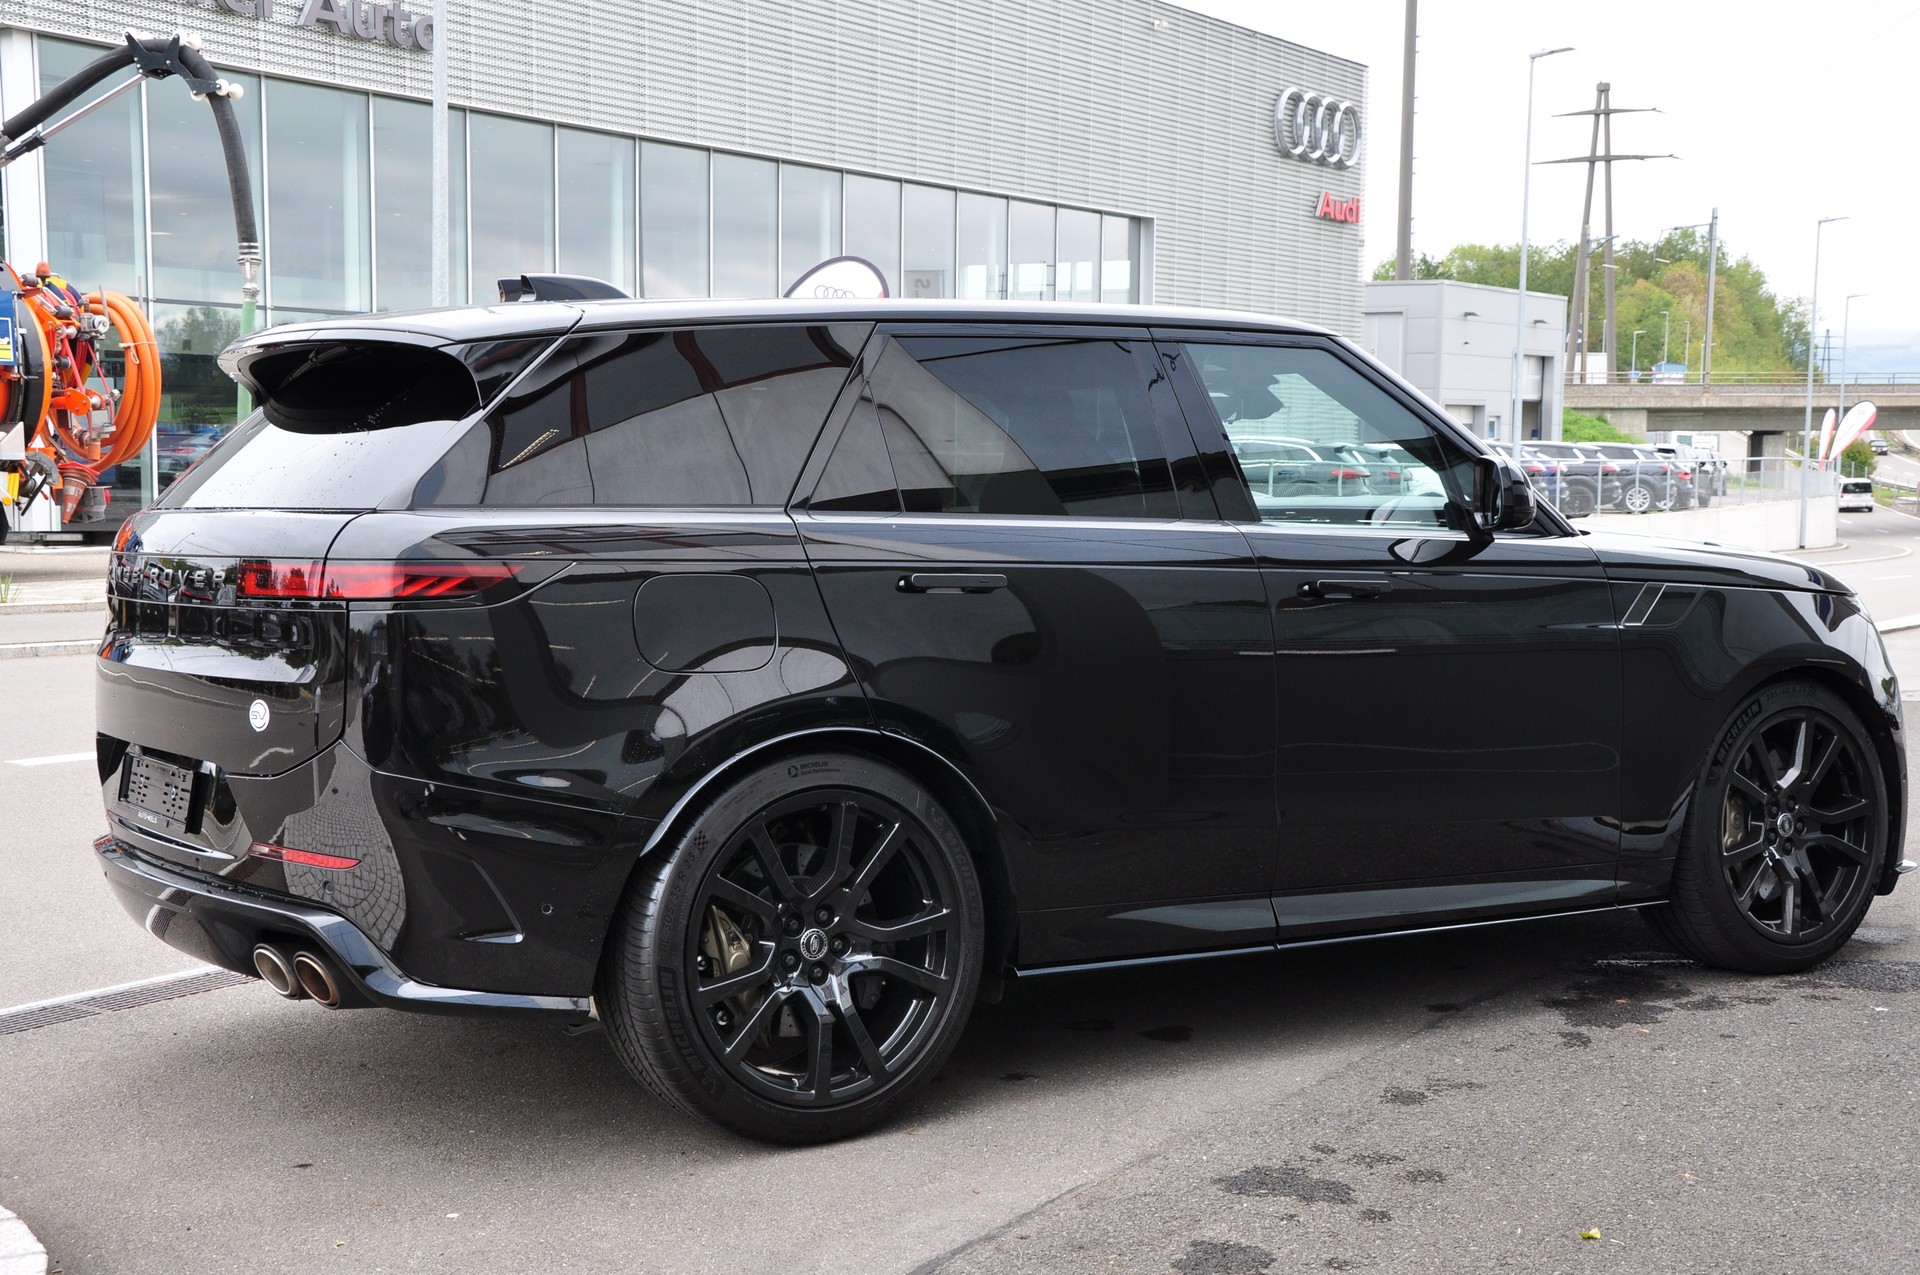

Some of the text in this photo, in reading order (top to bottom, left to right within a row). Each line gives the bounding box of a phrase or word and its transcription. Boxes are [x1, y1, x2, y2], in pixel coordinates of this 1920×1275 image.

[1316, 191, 1360, 223] Audi
[150, 567, 226, 590] ROVER
[1716, 701, 1760, 763] MICHELIN
[800, 760, 829, 770] MICHELIN
[677, 870, 687, 881] R
[944, 830, 982, 925] MICHELIN
[661, 970, 705, 1073] MICHELIN
